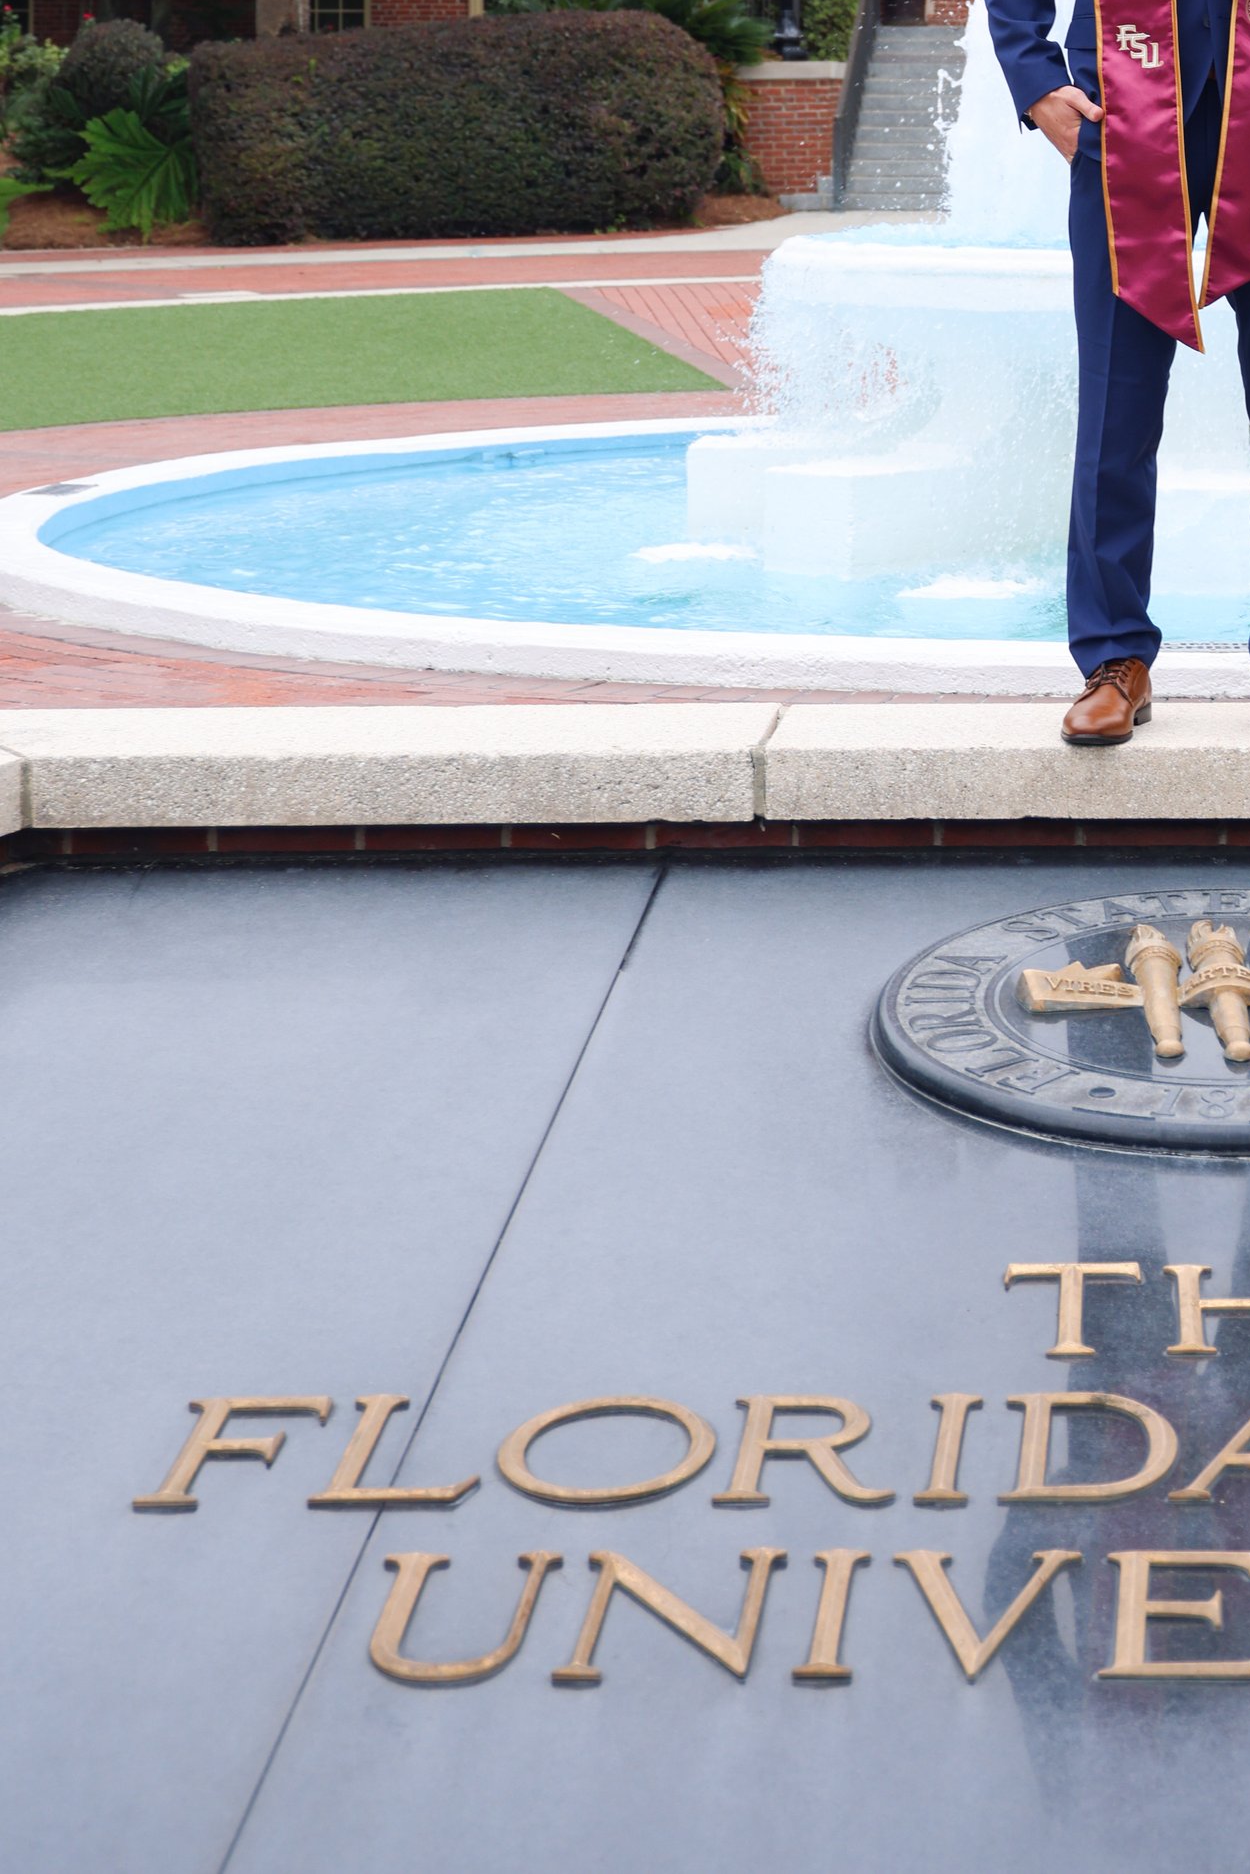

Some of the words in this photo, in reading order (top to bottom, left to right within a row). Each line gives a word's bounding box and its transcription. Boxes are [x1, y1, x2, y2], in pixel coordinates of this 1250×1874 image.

[1115, 24, 1164, 68] FSU
[1045, 975, 1134, 999] VIRES
[904, 955, 1080, 1095] FLORIDA
